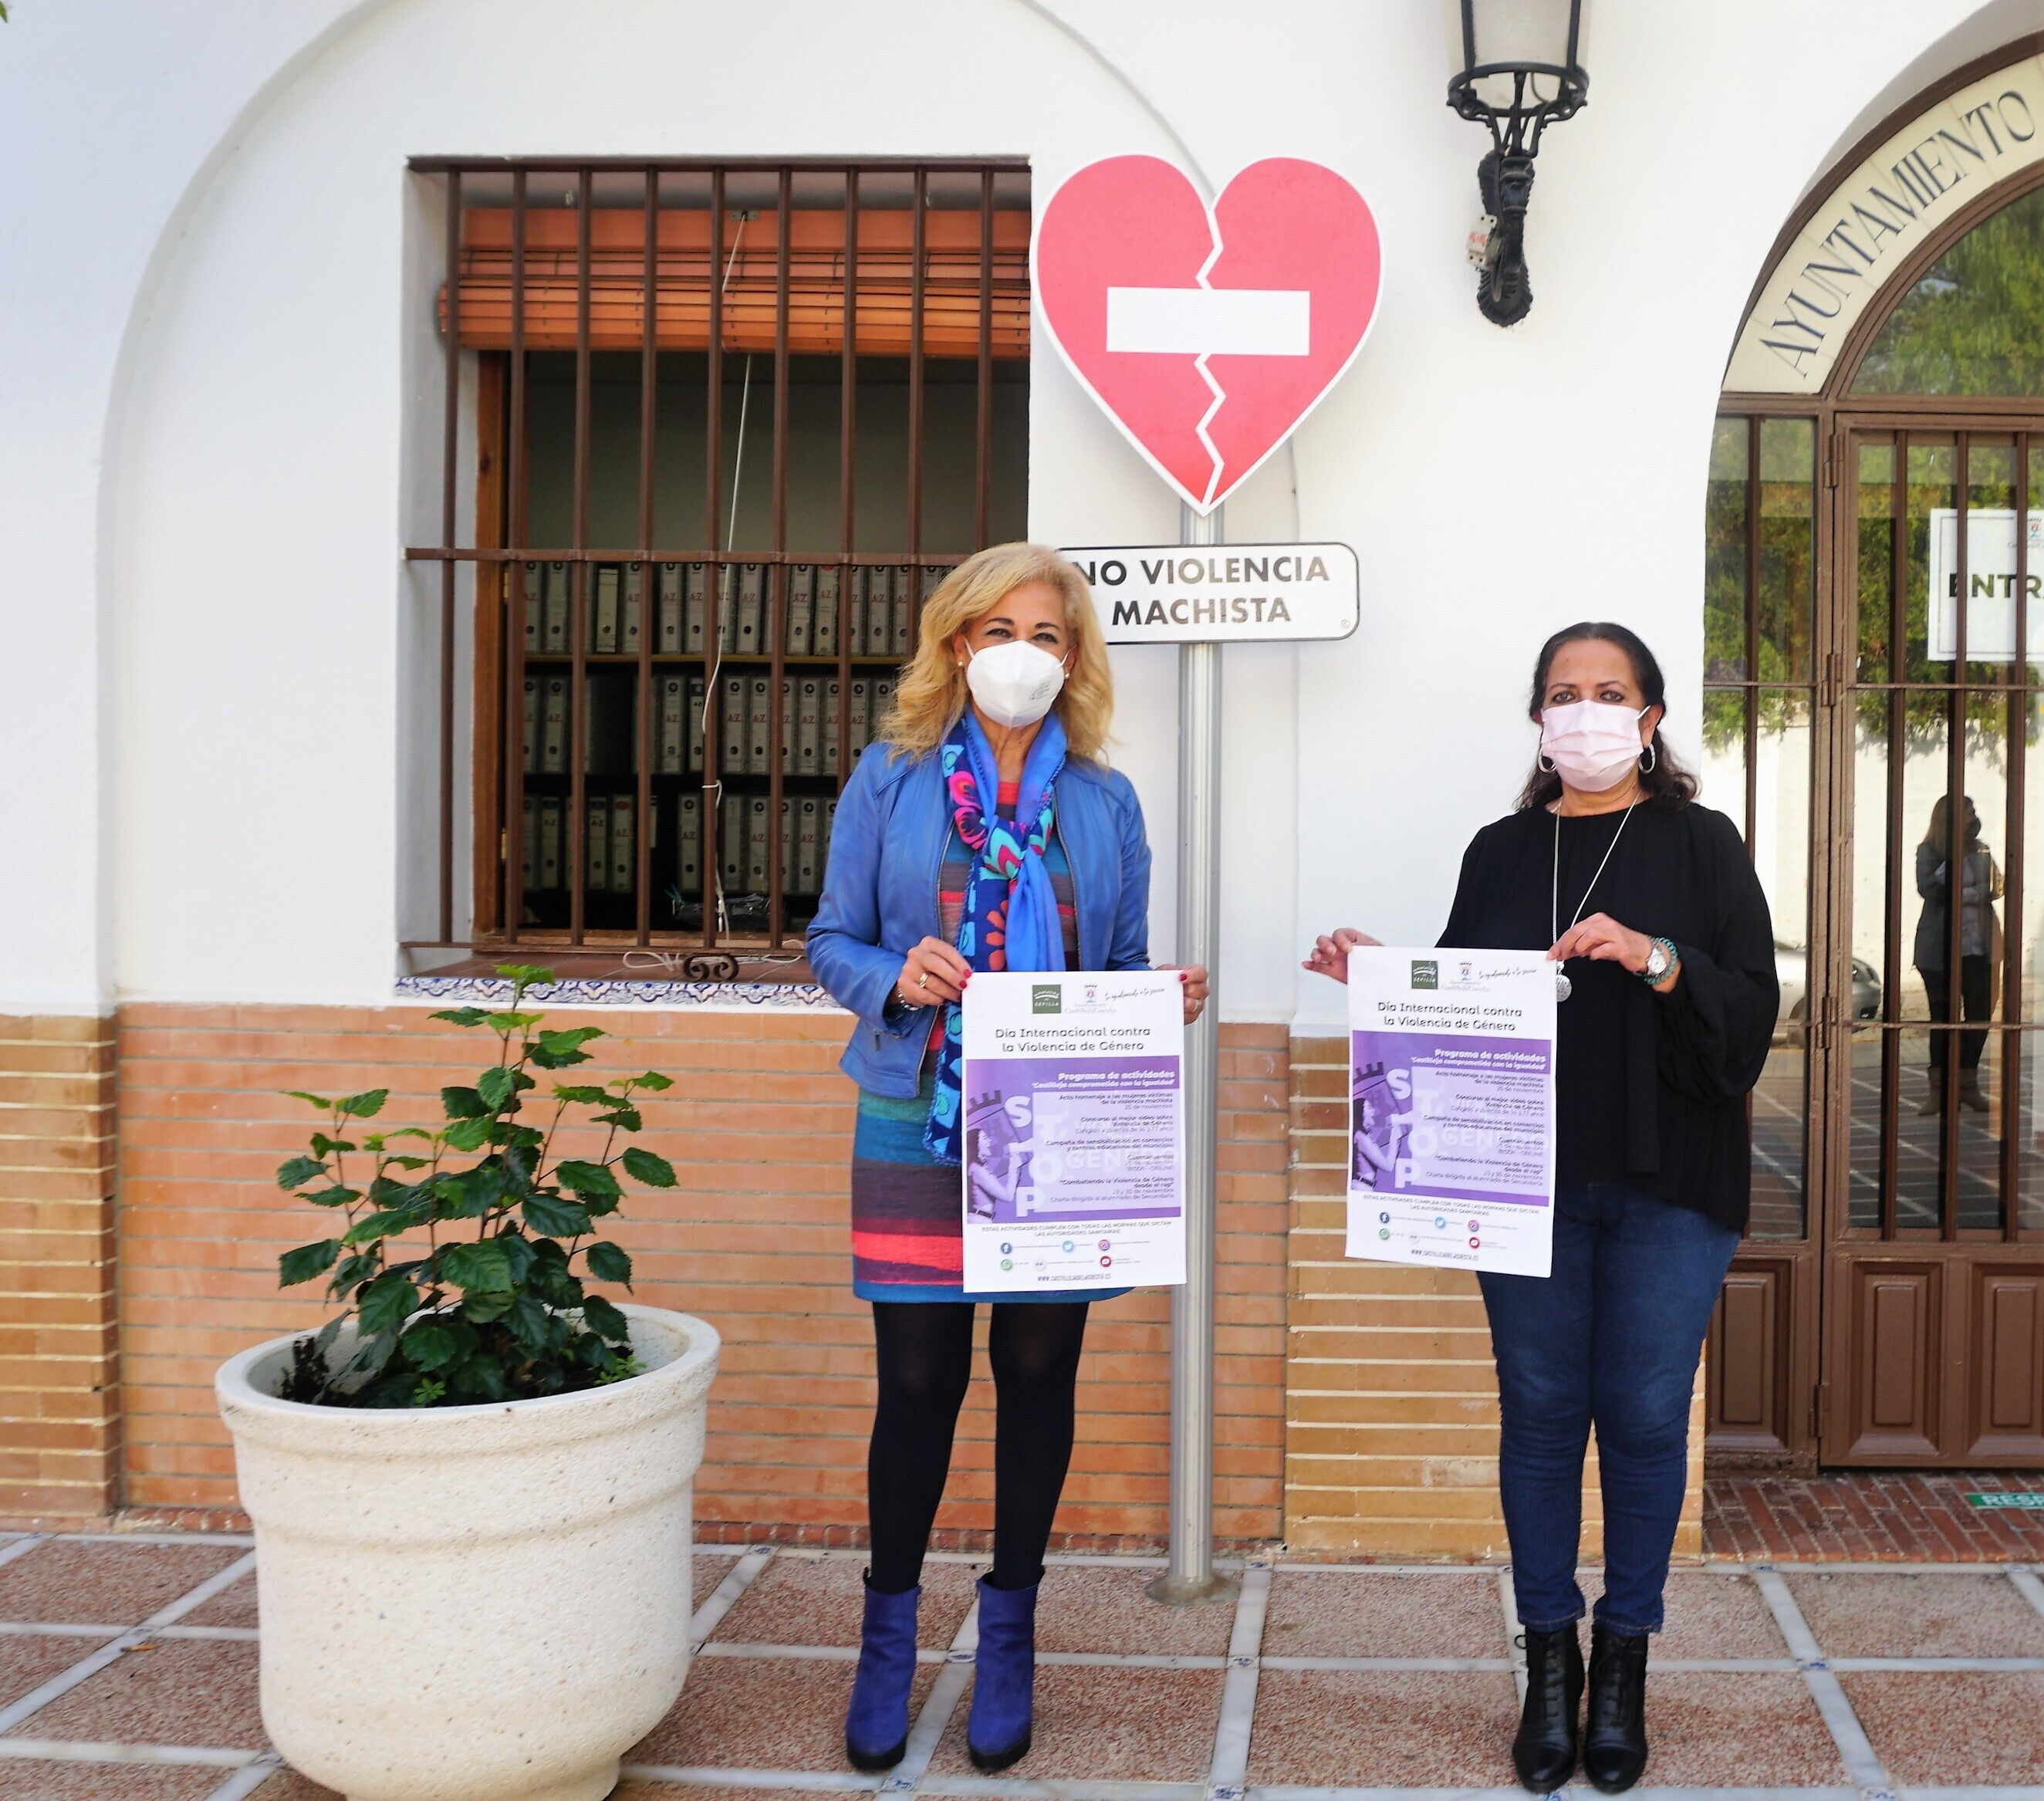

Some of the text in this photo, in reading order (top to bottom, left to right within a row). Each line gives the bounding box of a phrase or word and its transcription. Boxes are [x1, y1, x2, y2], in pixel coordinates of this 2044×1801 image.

[1759, 90, 2035, 379] AYUNTAMIENTO
[1073, 556, 1329, 586] NO VIOLENCIA
[1949, 573, 2044, 599] ENTR
[1112, 597, 1291, 626] MACHISTA
[1378, 1002, 1522, 1017] Día Internacional contra
[1384, 1016, 1515, 1031] la Violencia de Género
[995, 1027, 1150, 1038] Día Internacional contra
[1002, 1041, 1144, 1052] la Violencia de Género
[1435, 1049, 1479, 1059] Programa
[1493, 1052, 1546, 1063] actividades
[1058, 1073, 1106, 1082] Programa
[1121, 1070, 1174, 1079] actividades
